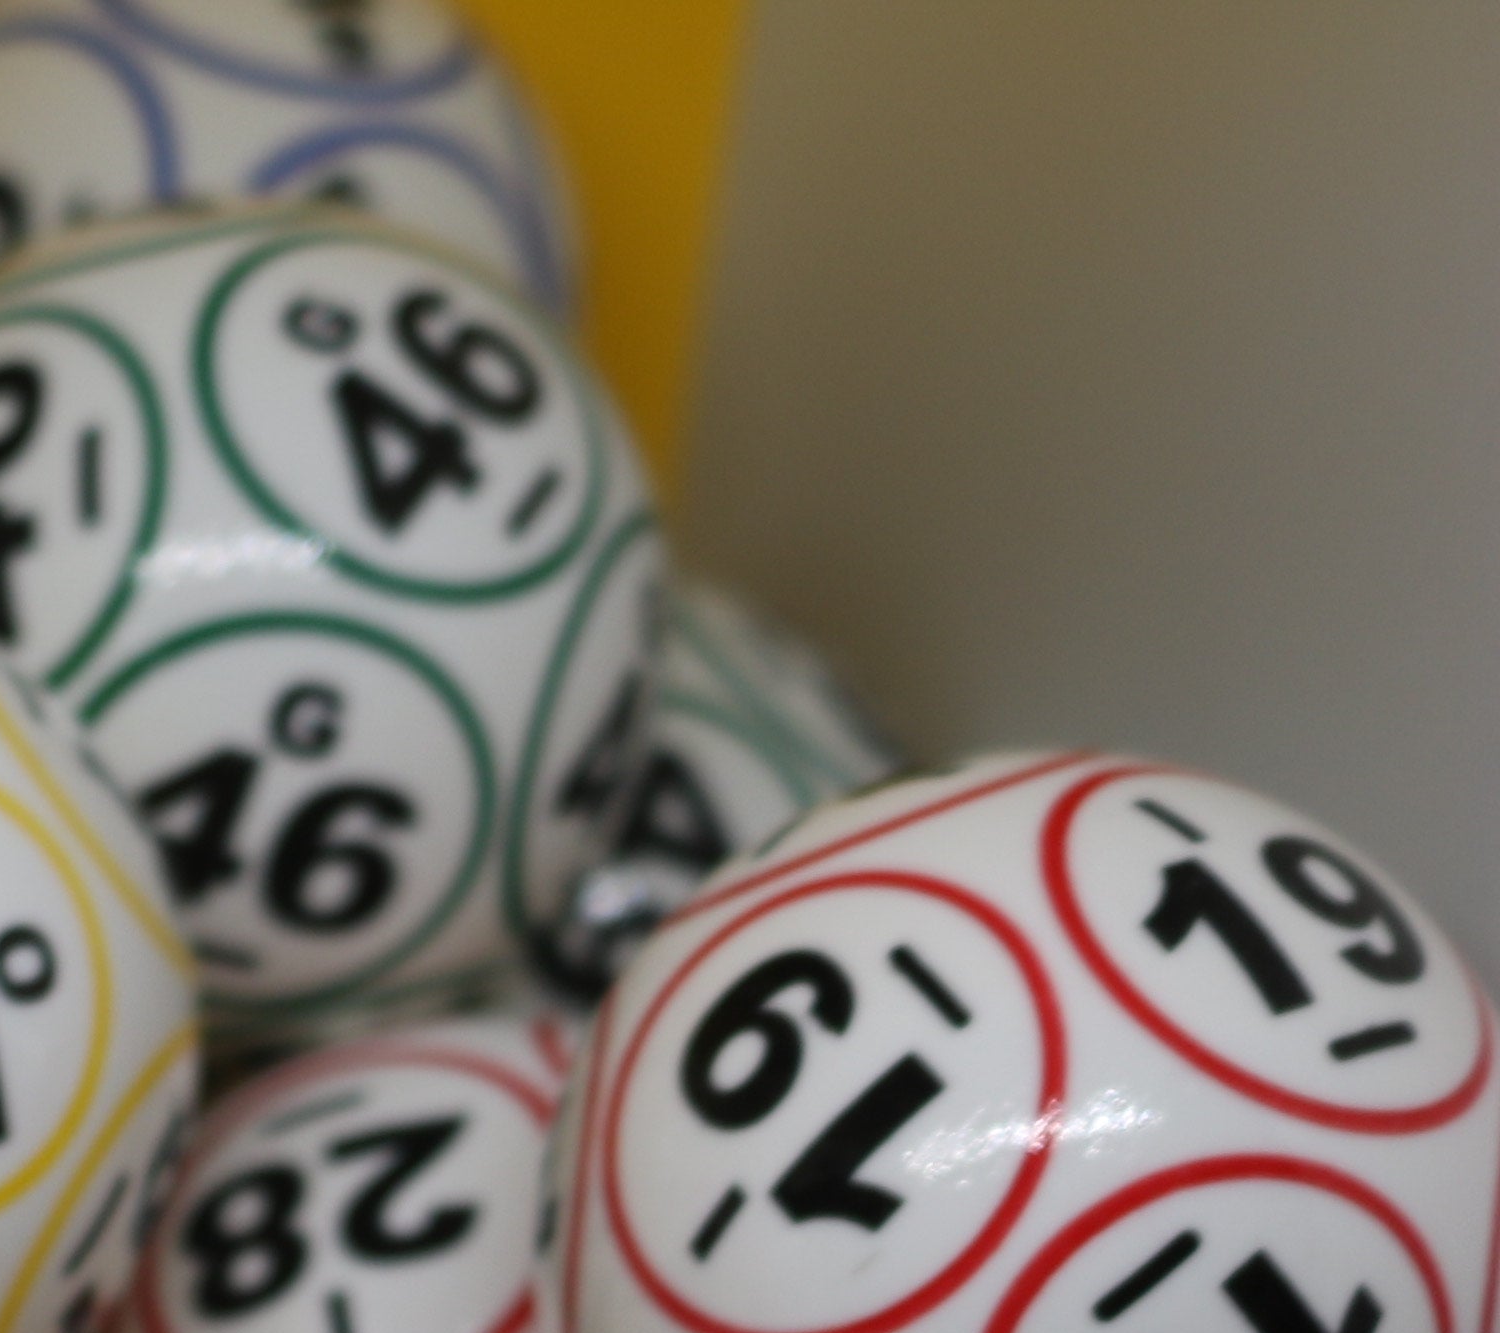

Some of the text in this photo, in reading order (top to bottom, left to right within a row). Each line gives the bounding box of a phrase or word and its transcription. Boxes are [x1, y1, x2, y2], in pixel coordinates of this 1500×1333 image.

[327, 286, 544, 538] 46
[267, 681, 348, 761] G
[131, 741, 425, 936] 46
[1141, 833, 1427, 1019] 19
[679, 945, 947, 1236] 19
[178, 1114, 485, 1322] 28
